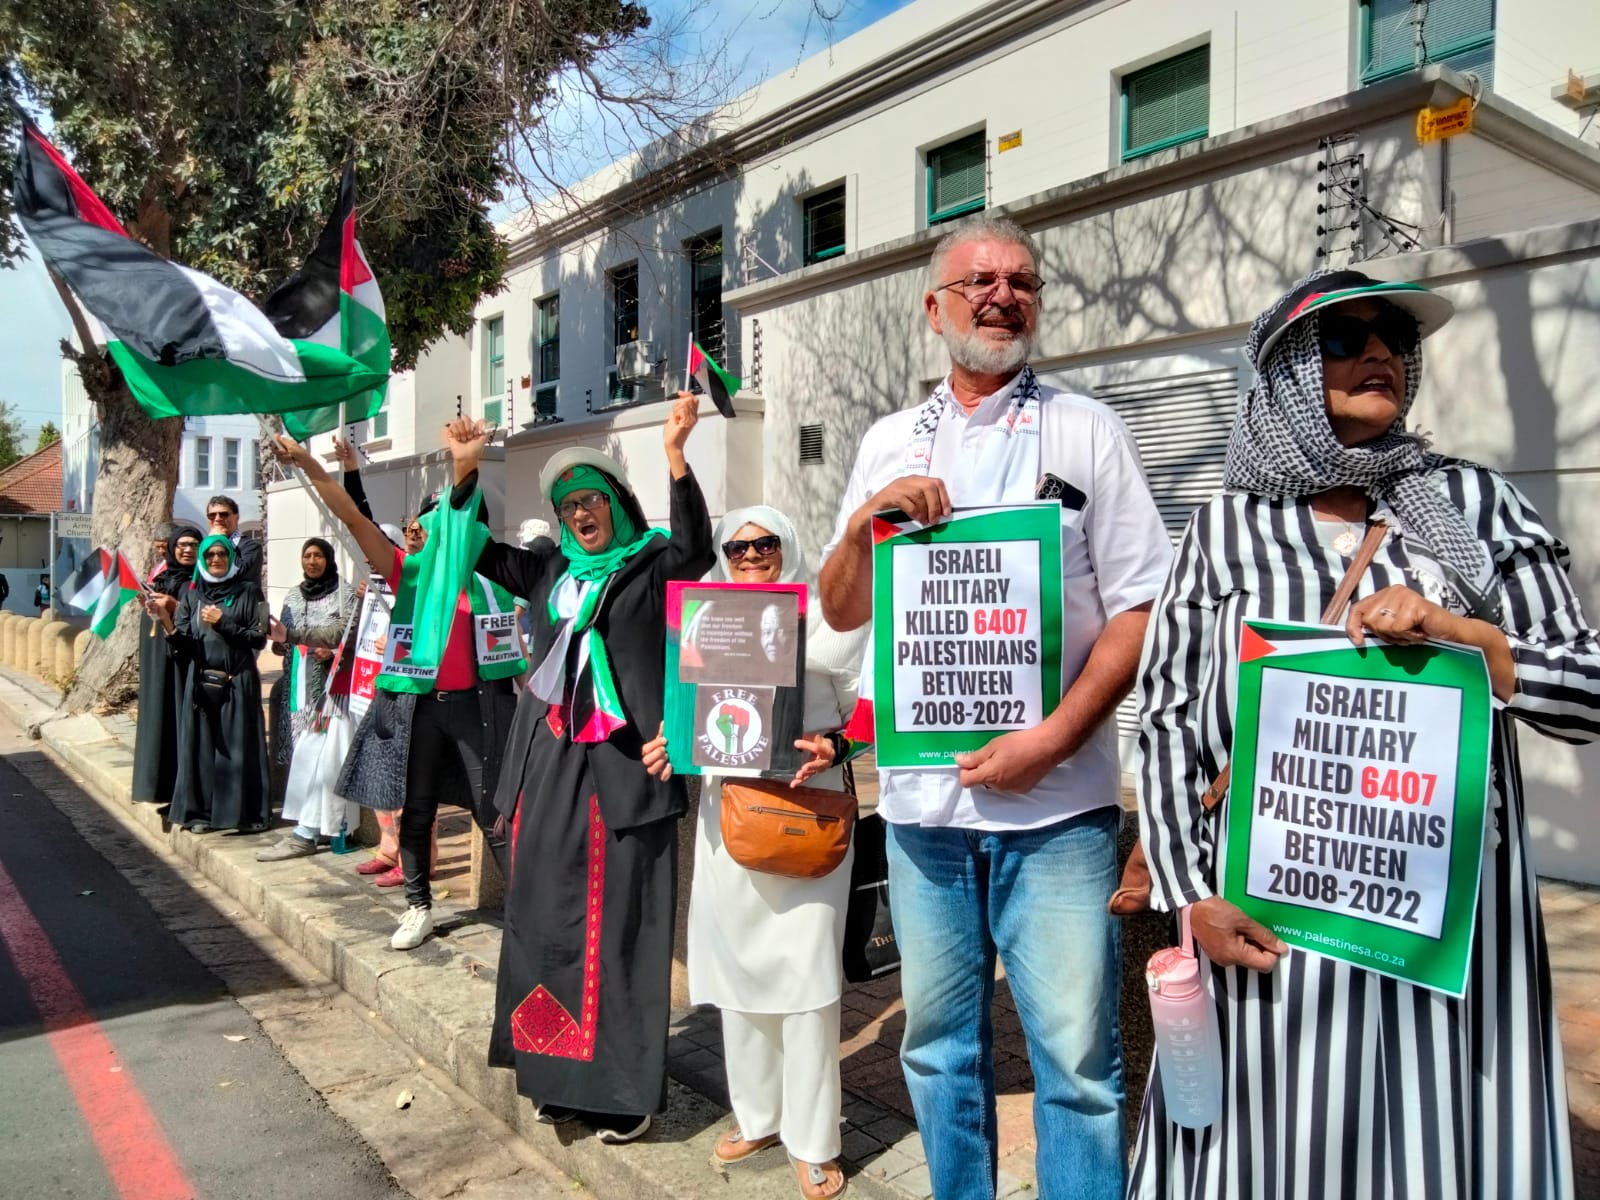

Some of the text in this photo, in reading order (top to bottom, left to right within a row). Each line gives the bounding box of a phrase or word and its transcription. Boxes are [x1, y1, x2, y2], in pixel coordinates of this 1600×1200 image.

[928, 547, 1001, 574] ISRAELI
[920, 577, 1011, 605] MILITARY
[393, 627, 413, 640] FR
[480, 614, 516, 630] FREE
[905, 608, 1028, 636] KILLED 6407
[483, 651, 520, 662] PALESTINE
[897, 639, 1038, 666] PALESTINIANS
[385, 665, 435, 676] PALESTINE
[922, 670, 1013, 696] BETWEEN
[711, 688, 758, 704] FREE
[1305, 681, 1408, 723] ISRAELI
[911, 700, 1026, 726] 2008-2022
[697, 733, 769, 766] PALESTINE
[918, 749, 975, 760] www.pal
[1292, 718, 1418, 764] MILITARY
[1270, 752, 1438, 807] KILLED 6407
[1258, 786, 1446, 849] PALESTINIANS
[1284, 829, 1408, 882] BETWEEN
[1268, 864, 1422, 924] 2008-2022
[1272, 923, 1405, 967] www.palestinesa.co.za
